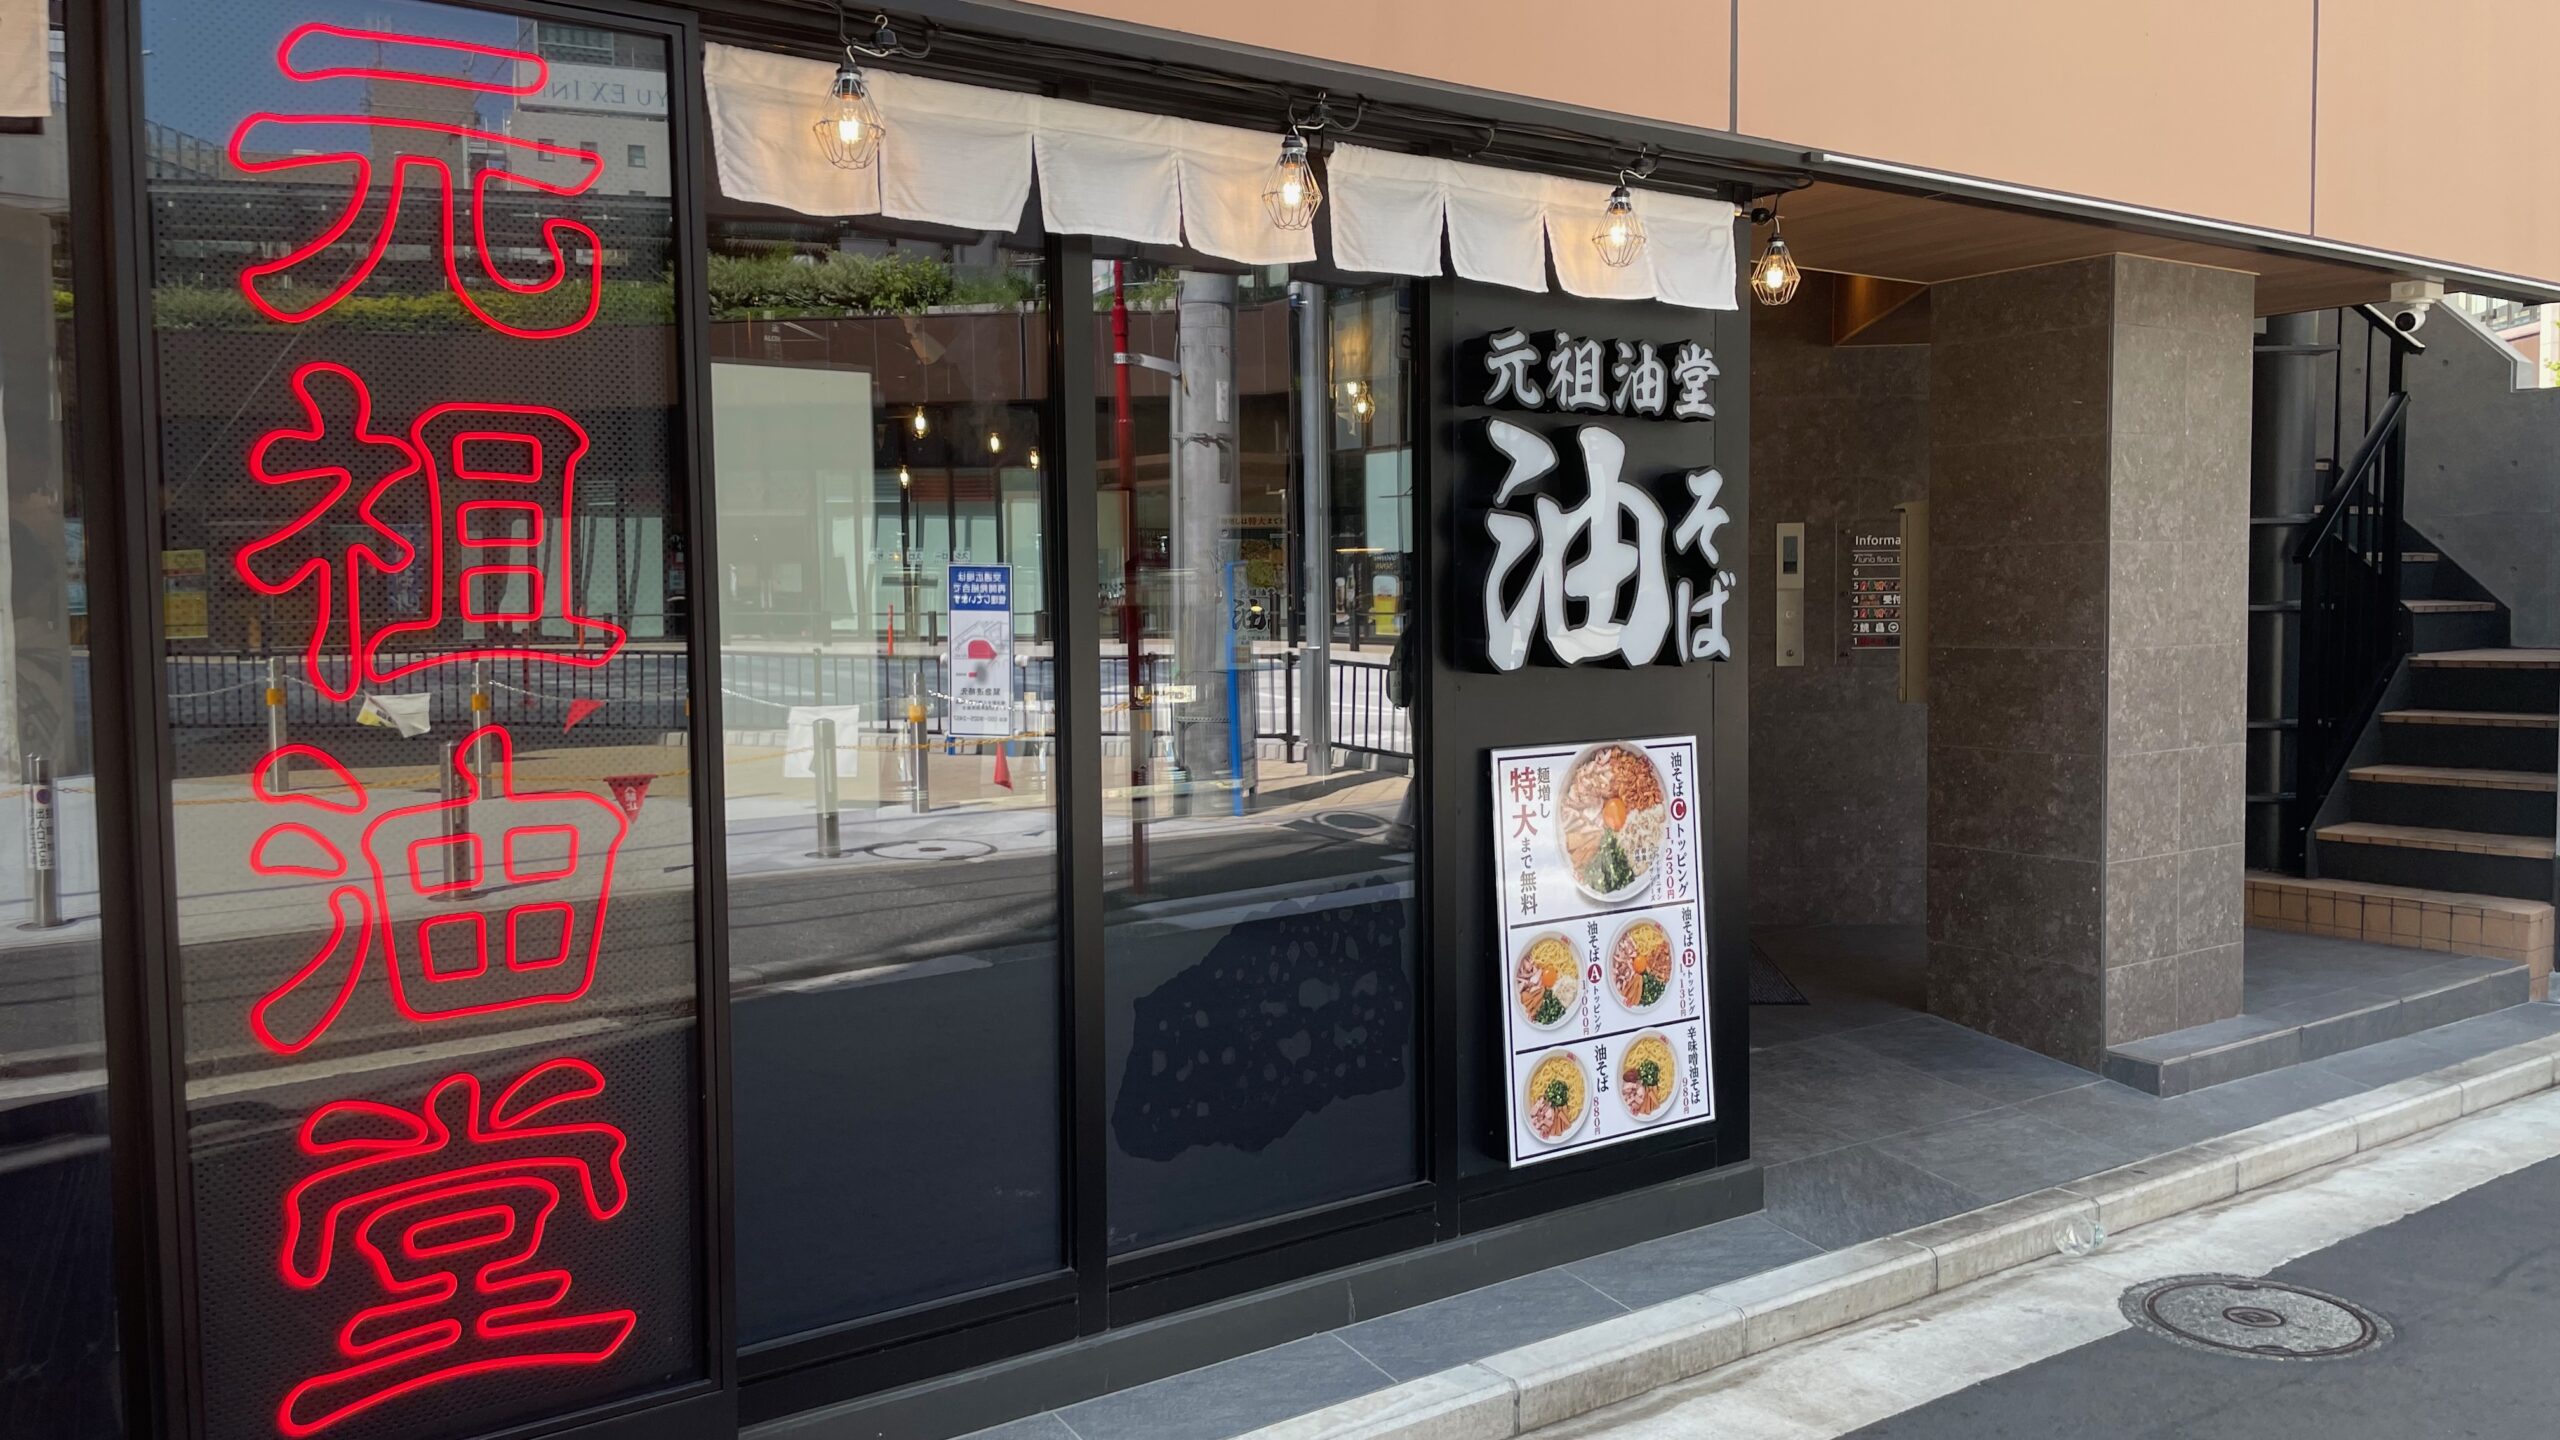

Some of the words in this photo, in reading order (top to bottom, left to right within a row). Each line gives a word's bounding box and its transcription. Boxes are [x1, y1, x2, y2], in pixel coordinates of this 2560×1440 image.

[1485, 330, 1720, 418] 元祖油堂
[1853, 582, 1859, 590] 5
[227, 22, 638, 1438] 元祖油堂
[1537, 767, 1551, 819] 麺増し
[1510, 766, 1538, 916] 特大まで無料
[1594, 1044, 1609, 1093] 油そば
[1593, 1097, 1601, 1136] 880円
[1682, 1077, 1690, 1115] 980円
